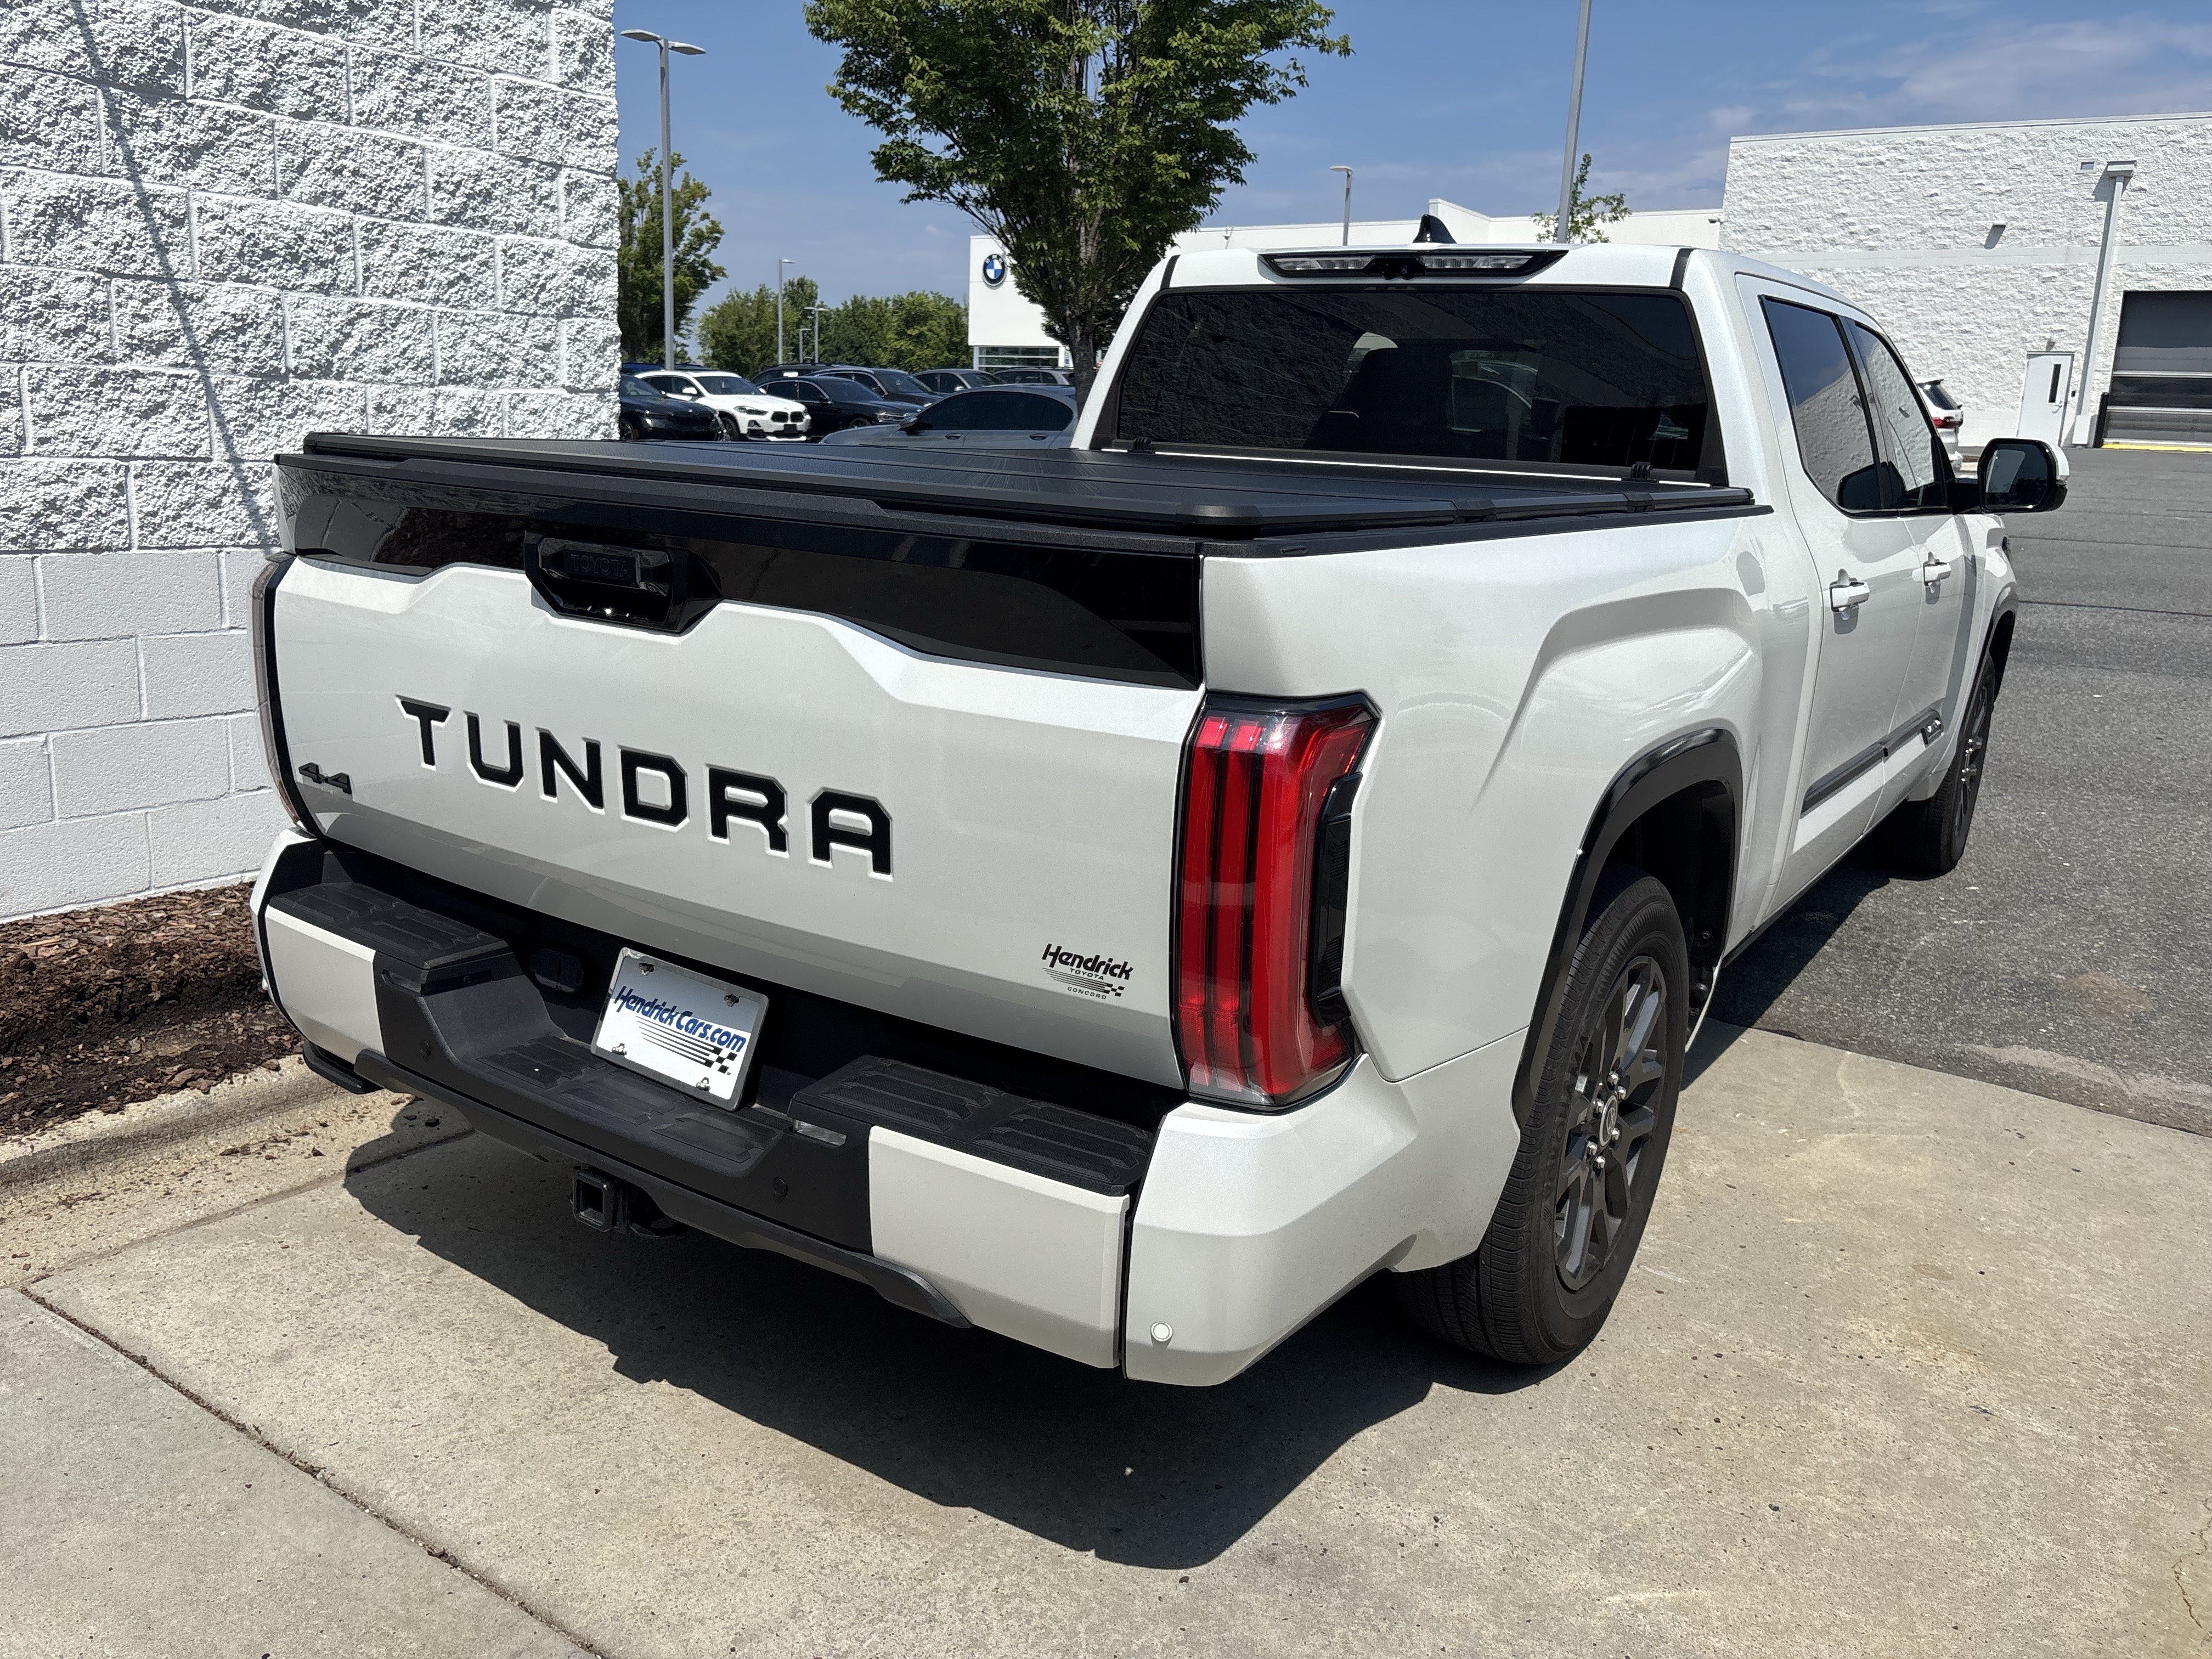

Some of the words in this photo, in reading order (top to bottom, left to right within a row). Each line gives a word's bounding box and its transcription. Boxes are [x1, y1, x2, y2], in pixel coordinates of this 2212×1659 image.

[570, 554, 629, 577] TOYOTA
[395, 695, 893, 881] TUNDRA
[1041, 943, 1134, 980] Hendrick
[1070, 968, 1104, 980] TOYOTA
[1067, 986, 1107, 1000] CONCORD
